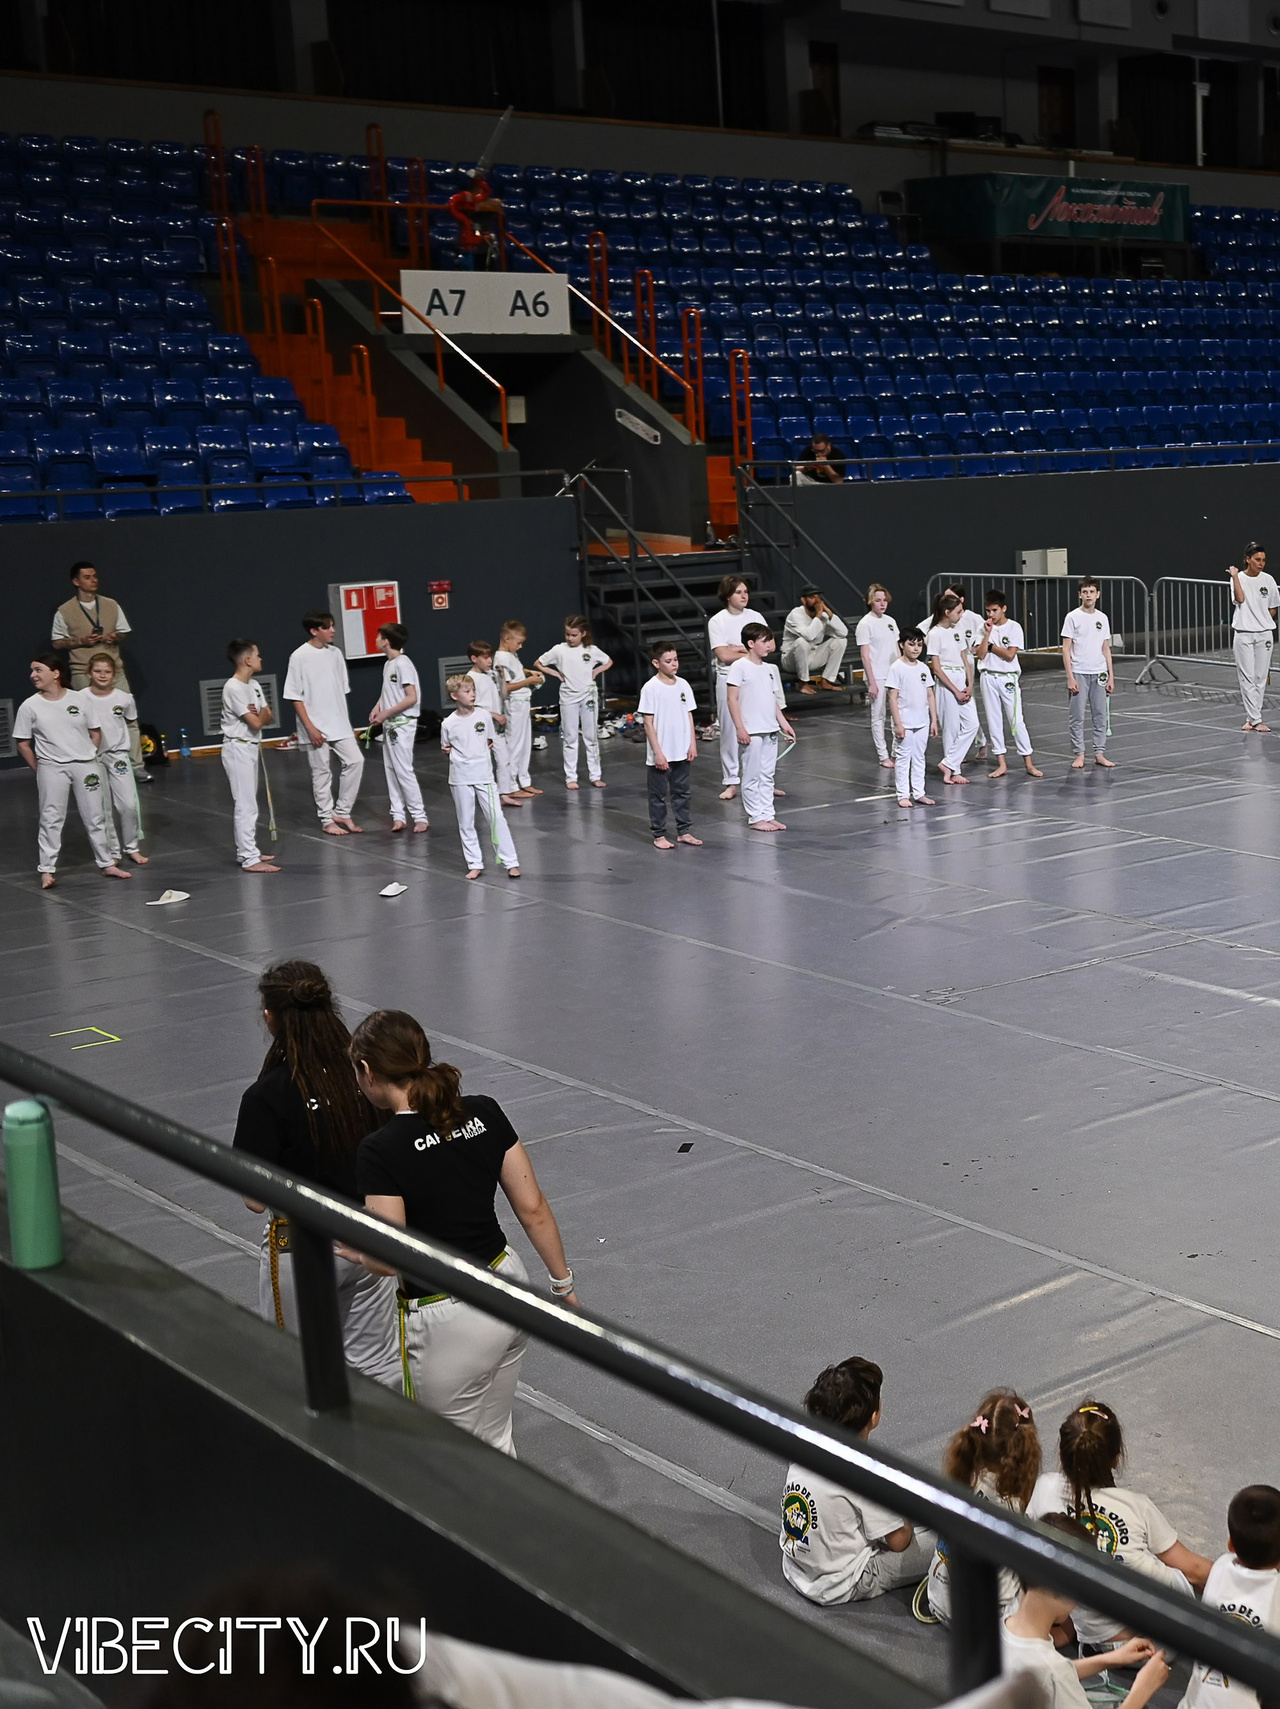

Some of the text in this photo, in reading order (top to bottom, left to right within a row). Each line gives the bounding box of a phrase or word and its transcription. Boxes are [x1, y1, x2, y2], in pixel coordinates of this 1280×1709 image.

[425, 288, 549, 318] A7 A6
[801, 1487, 812, 1500] DE
[809, 1499, 818, 1530] OURO
[1109, 1511, 1129, 1545] OURO
[1238, 1604, 1253, 1618] DE
